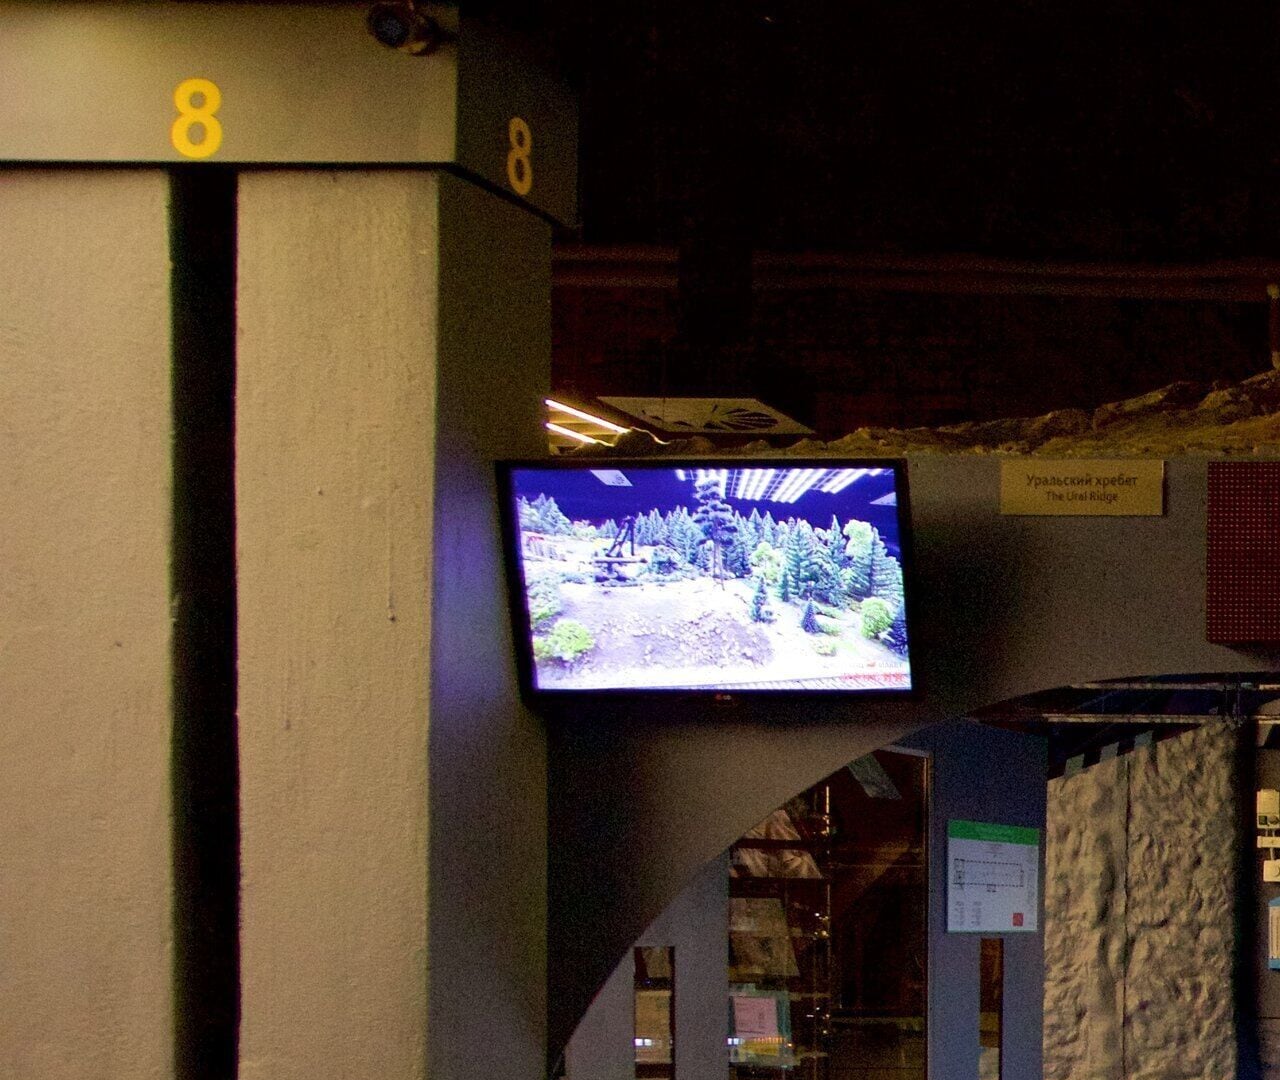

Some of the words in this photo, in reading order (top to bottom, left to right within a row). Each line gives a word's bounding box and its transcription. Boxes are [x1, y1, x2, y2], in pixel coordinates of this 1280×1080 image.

[170, 77, 224, 159] 8
[507, 117, 533, 196] 8
[1026, 473, 1092, 488] Уральский
[1095, 474, 1138, 488] хребет
[1046, 491, 1064, 501] The
[1067, 491, 1088, 501] Ural
[1090, 491, 1118, 503] Ridge
